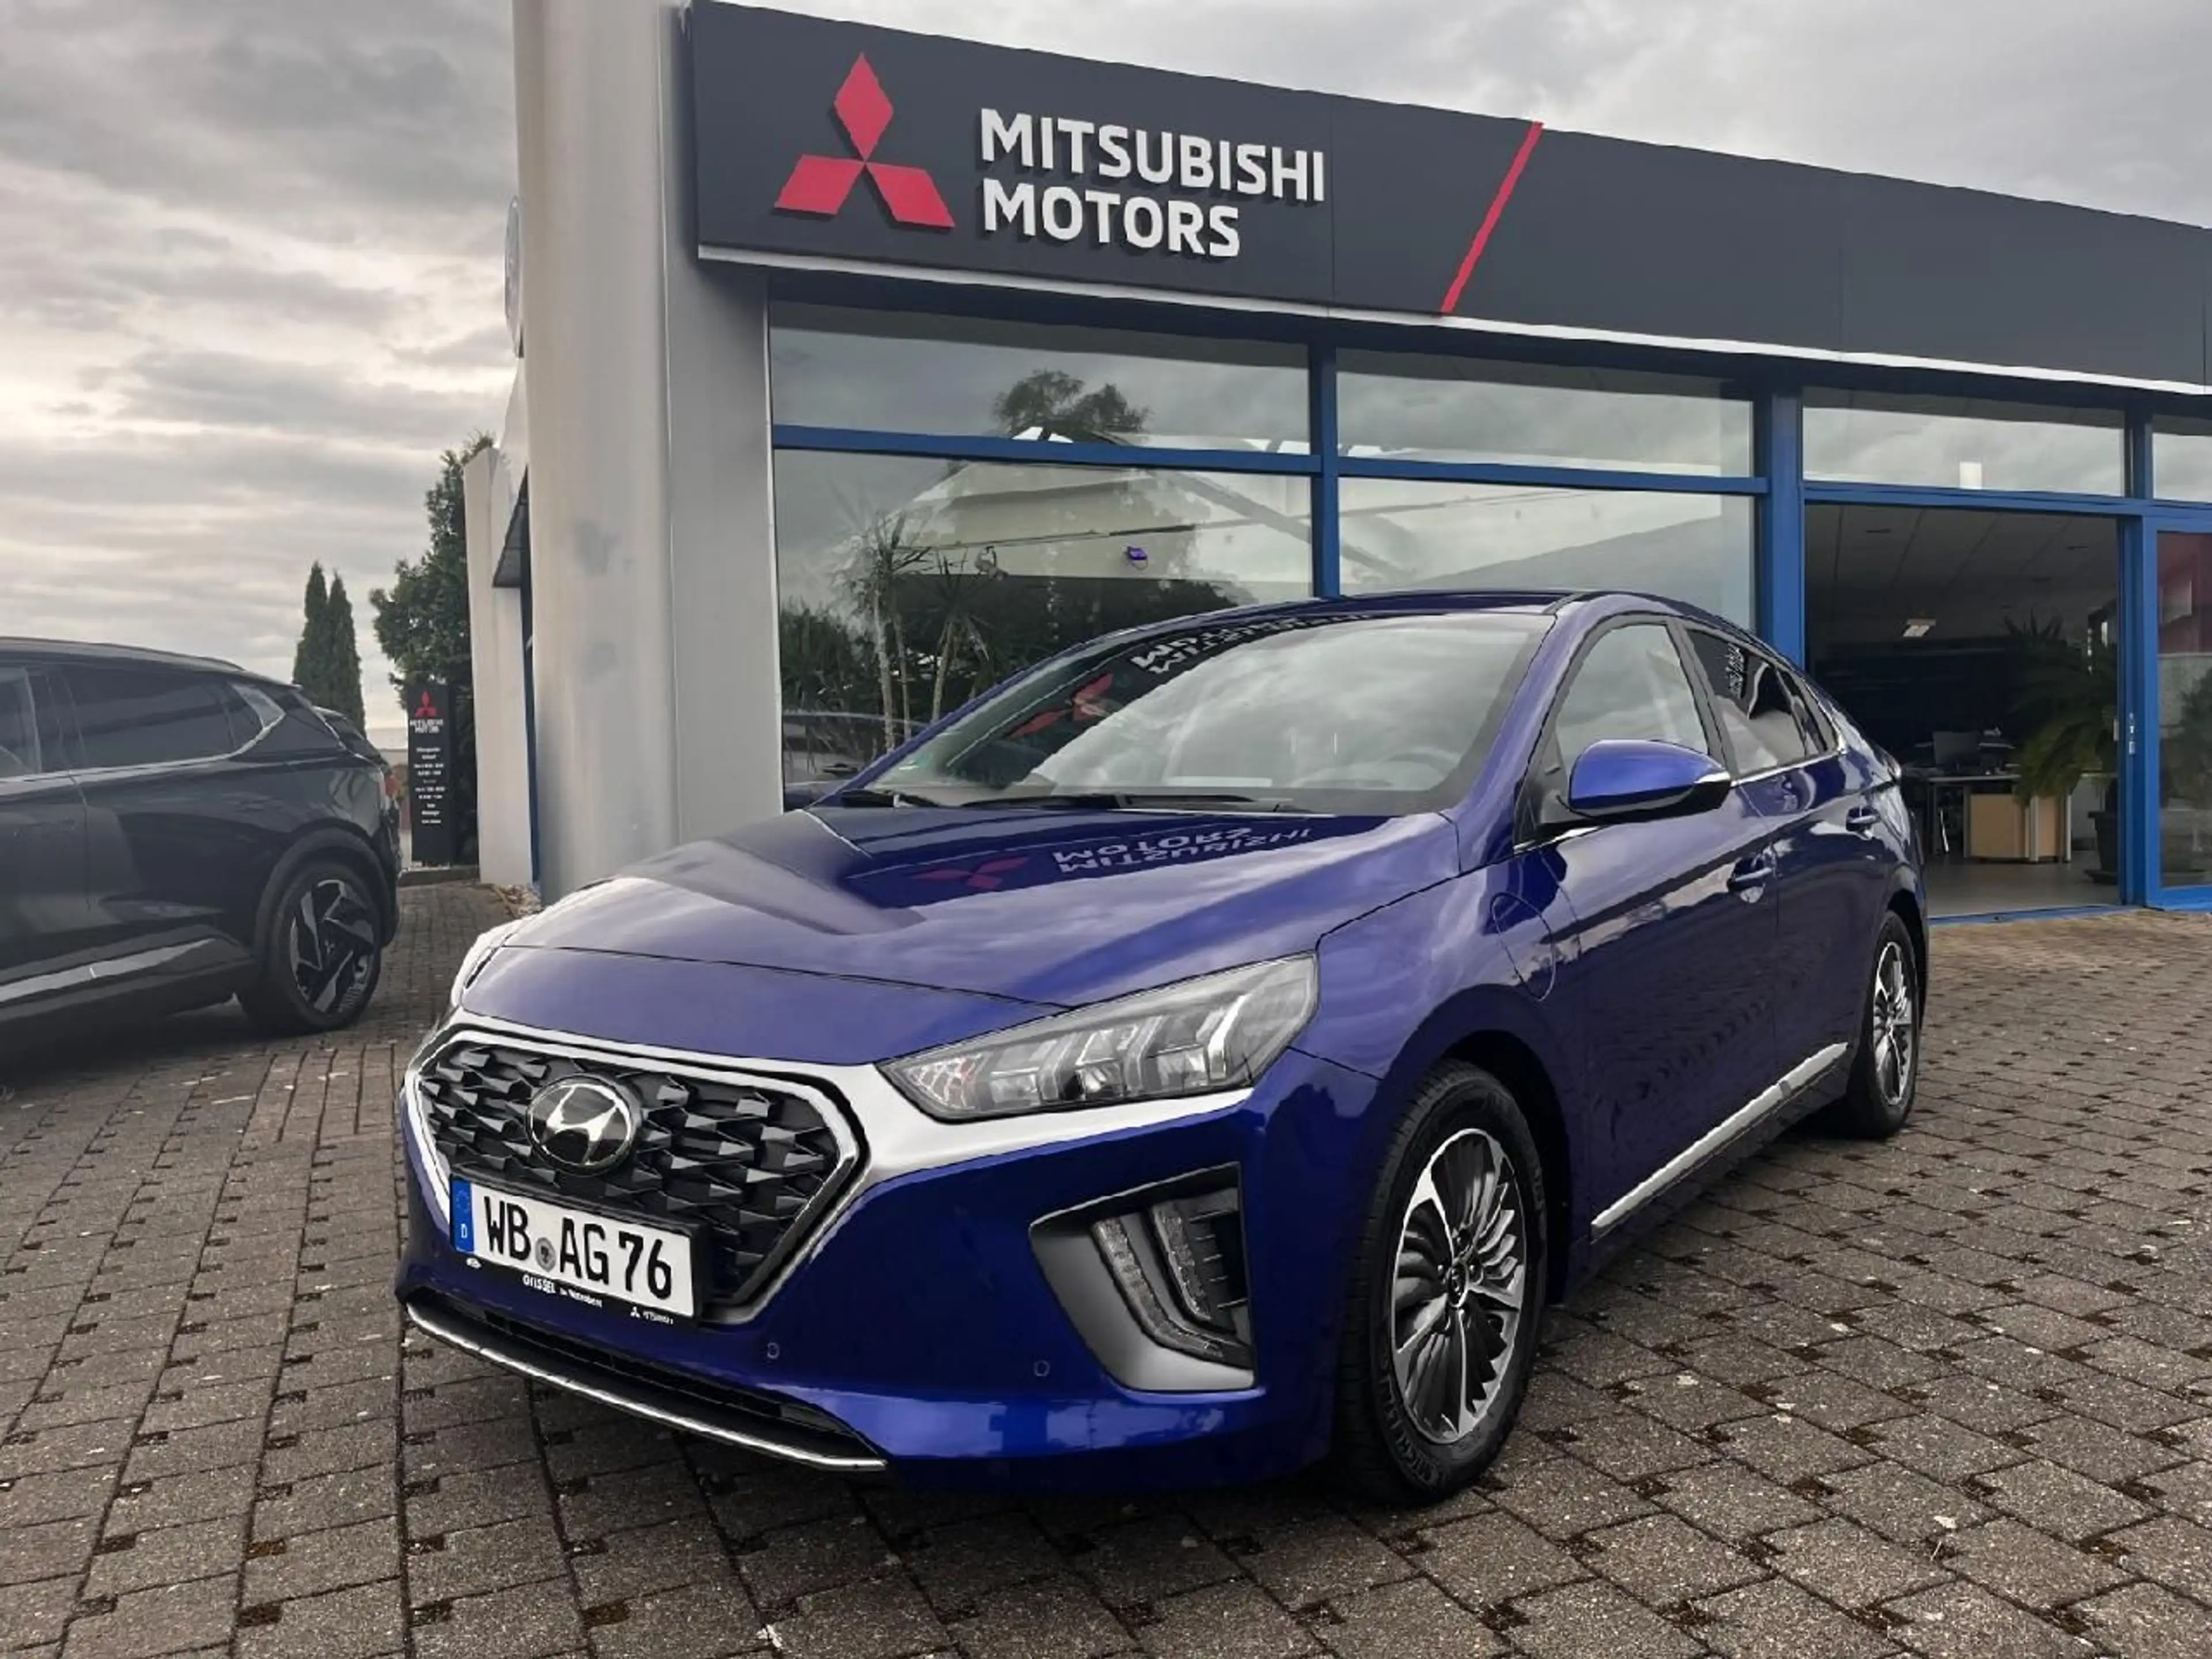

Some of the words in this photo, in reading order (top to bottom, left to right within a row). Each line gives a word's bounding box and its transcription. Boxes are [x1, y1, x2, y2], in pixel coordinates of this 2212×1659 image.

[981, 108, 1324, 202] MITSUBISHI
[983, 177, 1240, 257] MOTORS
[461, 1223, 467, 1239] D
[484, 1195, 531, 1261] WB
[559, 1217, 609, 1285] AG
[618, 1230, 673, 1300] 76
